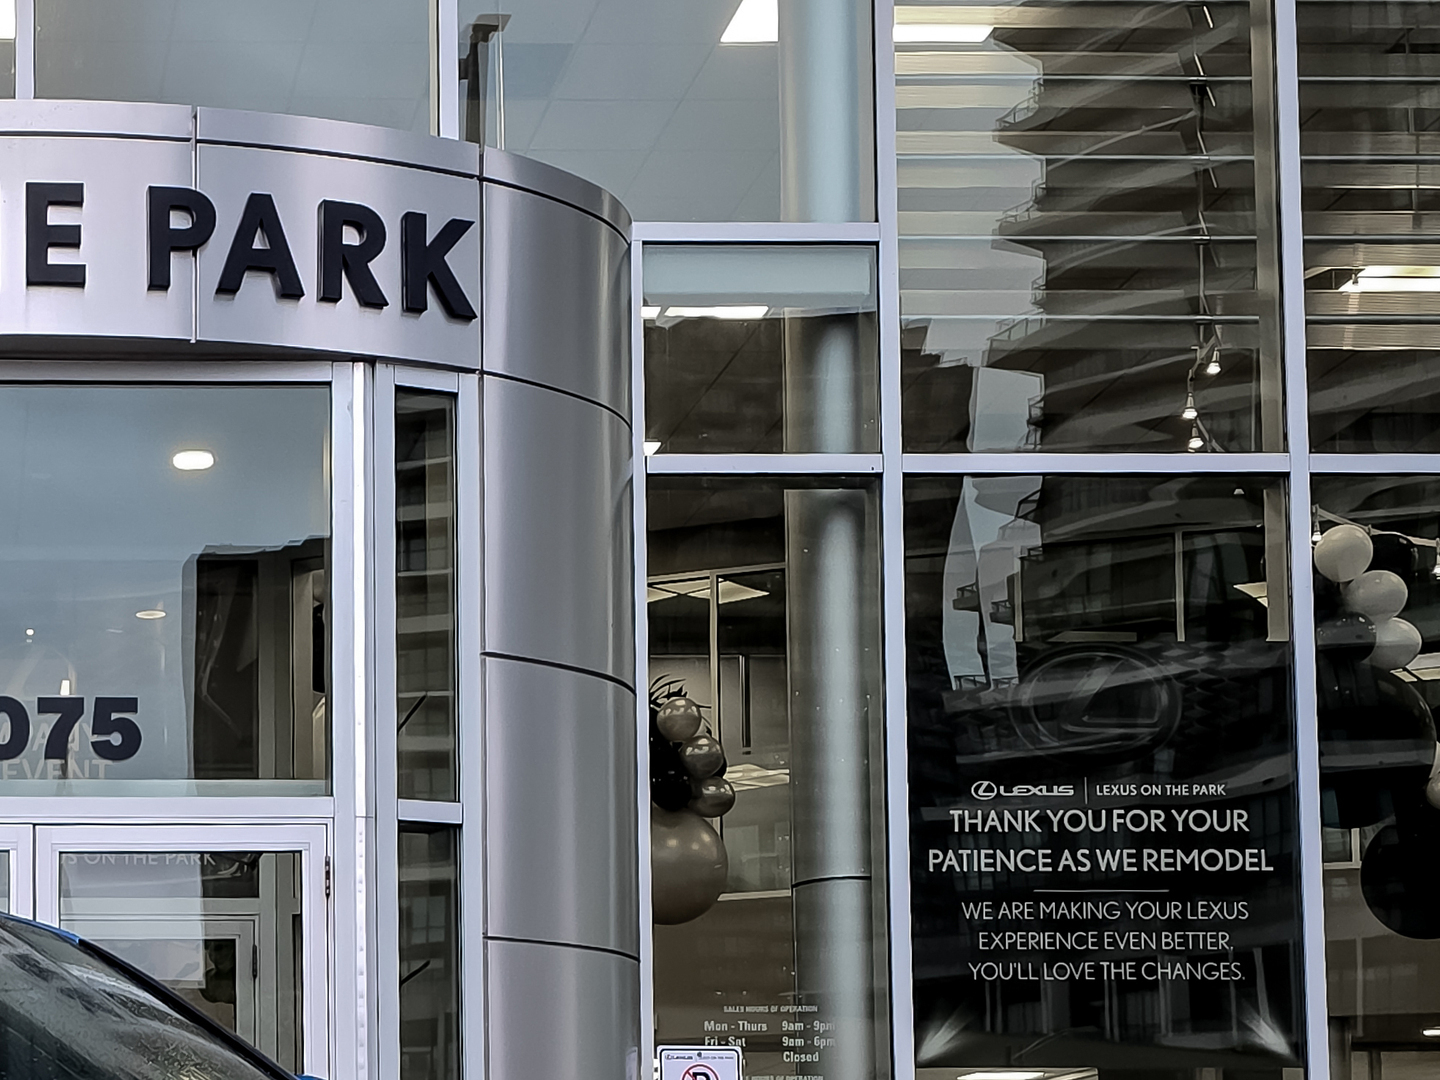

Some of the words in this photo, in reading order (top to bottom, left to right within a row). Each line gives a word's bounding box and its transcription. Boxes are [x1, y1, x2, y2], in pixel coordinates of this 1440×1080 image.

[147, 185, 477, 321] PARK
[999, 785, 1074, 797] LEXUS
[1096, 784, 1137, 796] LEXUS
[1141, 784, 1161, 796] ON
[1165, 784, 1189, 796] THE
[1192, 784, 1226, 796] PARK
[949, 809, 1042, 833] THANK
[1046, 809, 1106, 832] YOU
[1112, 809, 1167, 832] FOR
[1171, 809, 1250, 832] YOUR
[928, 848, 1052, 873] PATIENCE
[1057, 849, 1091, 872] AS
[1095, 849, 1138, 872] WE
[1142, 849, 1274, 872] REMODEL
[961, 901, 993, 920] WE
[998, 901, 1034, 920] ARE
[1040, 901, 1121, 920] MAKING
[1125, 901, 1182, 920] YOUR
[1187, 901, 1249, 920] LEXUS
[978, 932, 1099, 950] EXPERIENCE
[1104, 932, 1157, 950] EVEN
[968, 962, 1039, 981] YOU'LL
[1044, 962, 1095, 981] LOVE
[1100, 962, 1137, 981] THE
[1141, 962, 1246, 981] CHANGES.
[704, 1020, 728, 1032] Mon
[738, 1020, 768, 1032] Thurs
[782, 1020, 804, 1032] 9am
[813, 1020, 836, 1034] 9pm
[704, 1036, 718, 1046] Fri
[728, 1036, 746, 1047] Sat
[782, 1036, 805, 1047] 9am
[814, 1035, 837, 1049] 6pm
[783, 1051, 820, 1062] Closed
